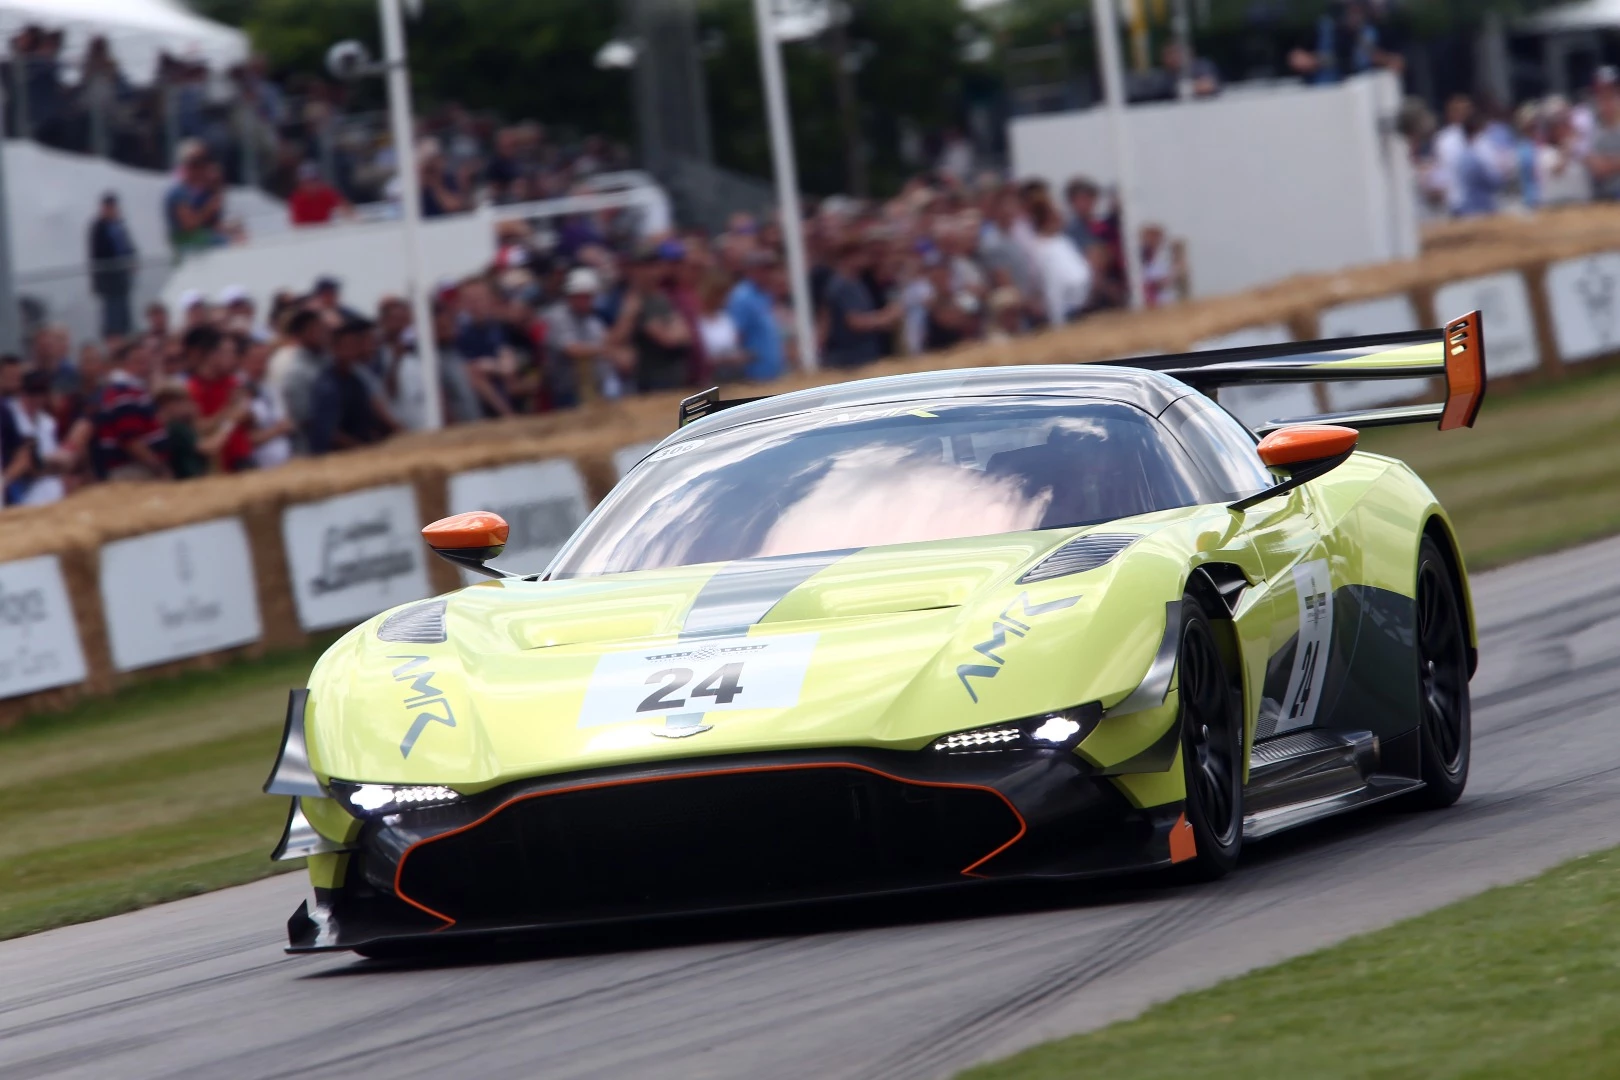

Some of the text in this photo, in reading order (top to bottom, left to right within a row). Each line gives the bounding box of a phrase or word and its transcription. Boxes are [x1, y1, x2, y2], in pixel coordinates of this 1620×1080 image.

[635, 662, 745, 713] 24
[956, 591, 1083, 704] AMR
[1288, 640, 1320, 719] 24
[386, 655, 456, 760] AMR
